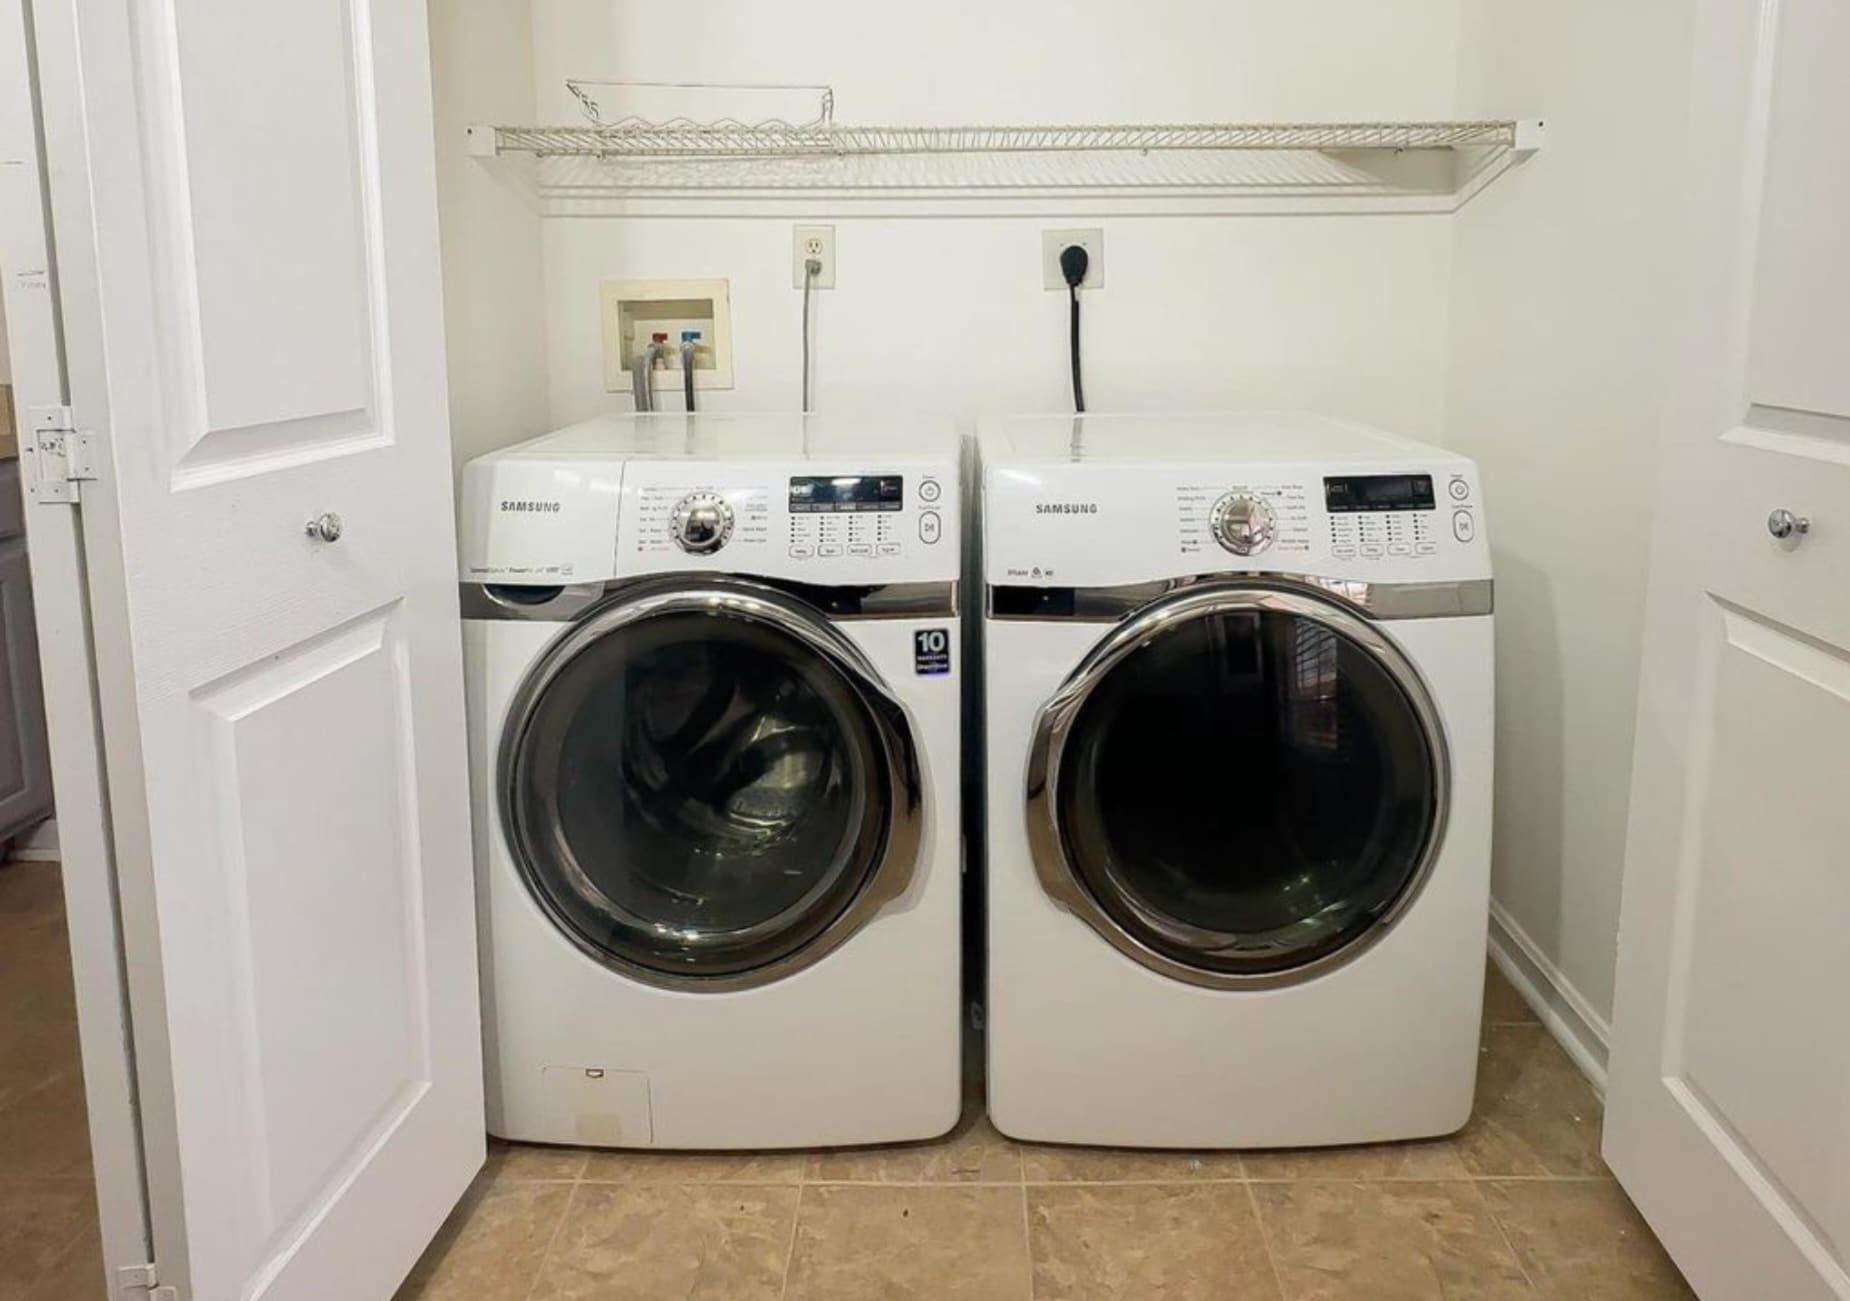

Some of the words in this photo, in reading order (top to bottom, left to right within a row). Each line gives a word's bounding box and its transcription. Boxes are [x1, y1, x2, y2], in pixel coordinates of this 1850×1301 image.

[500, 501, 561, 513] SAMSUNG
[1035, 503, 1098, 514] SAMSUNG
[917, 631, 946, 652] 10
